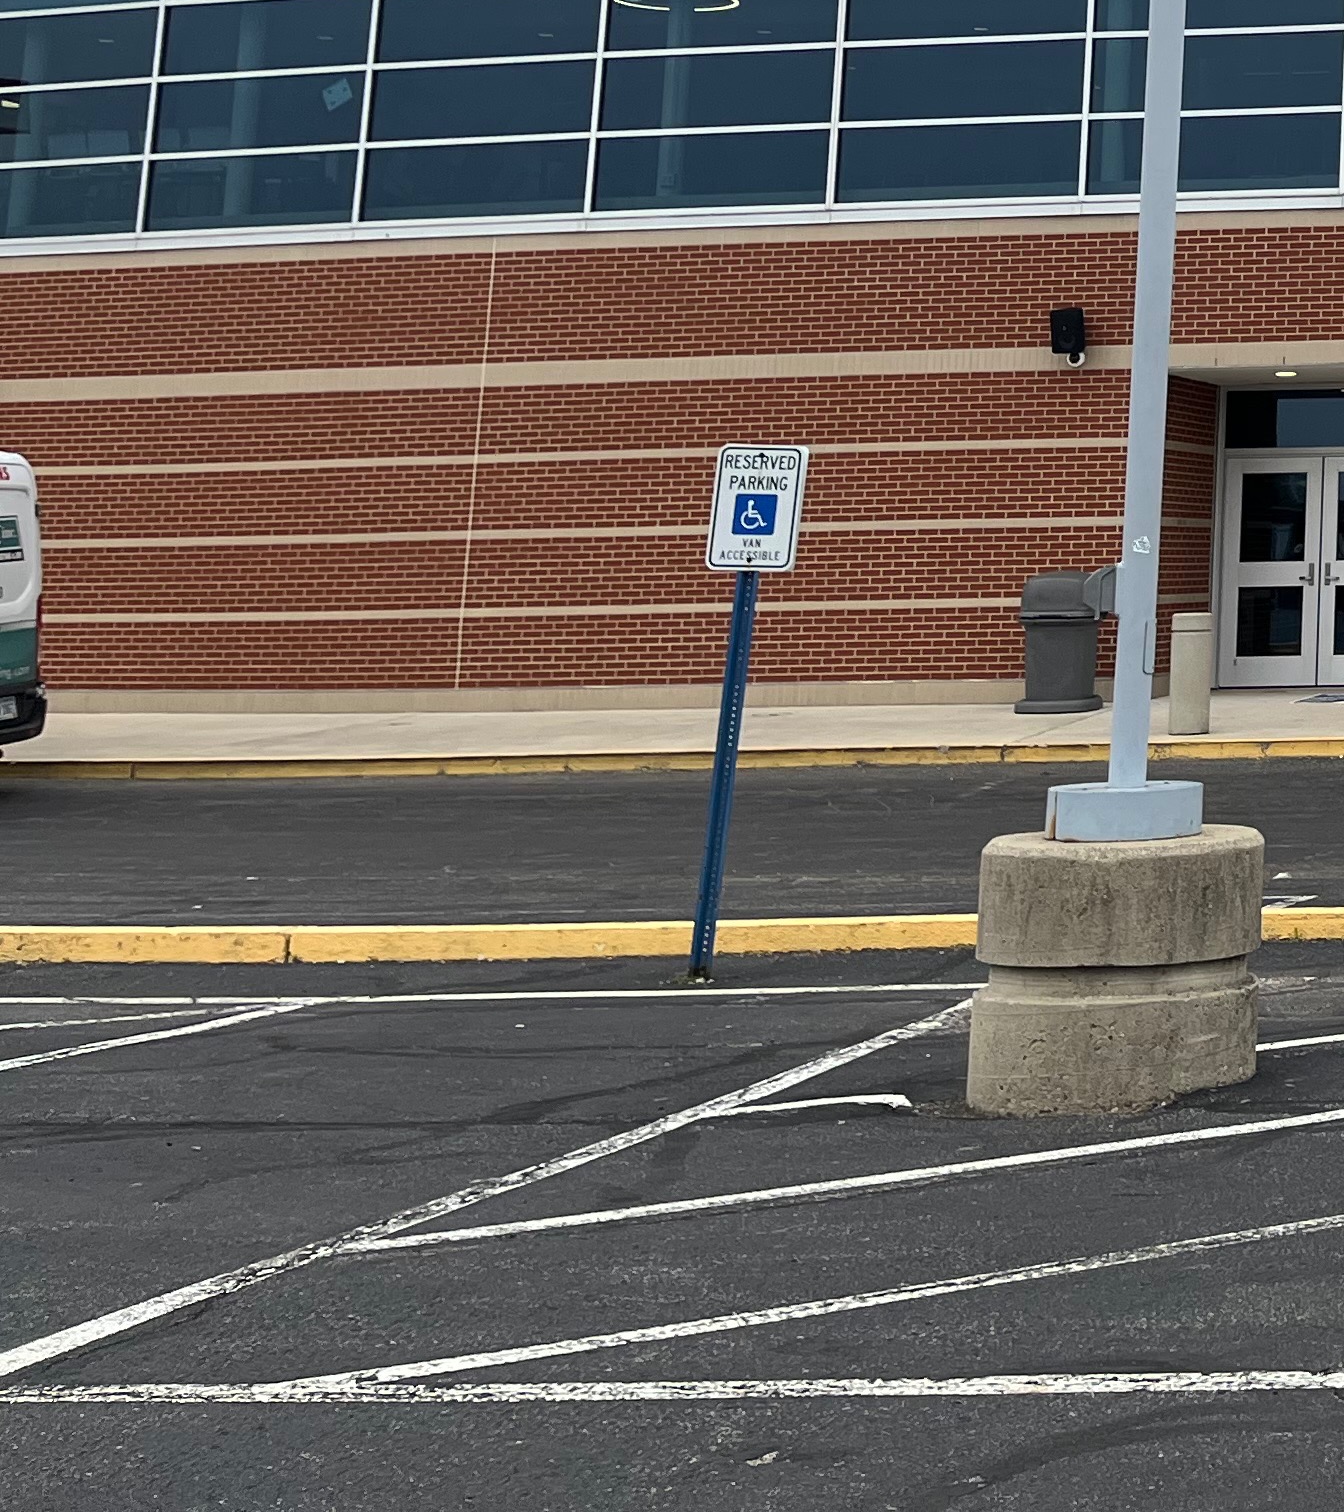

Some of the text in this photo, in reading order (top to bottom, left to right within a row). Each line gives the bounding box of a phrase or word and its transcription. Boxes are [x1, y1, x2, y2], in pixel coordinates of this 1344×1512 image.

[724, 454, 797, 471] RESERVED
[729, 475, 789, 491] PARKING
[742, 538, 762, 548] VAN
[719, 550, 781, 561] ACCESSIBLE
